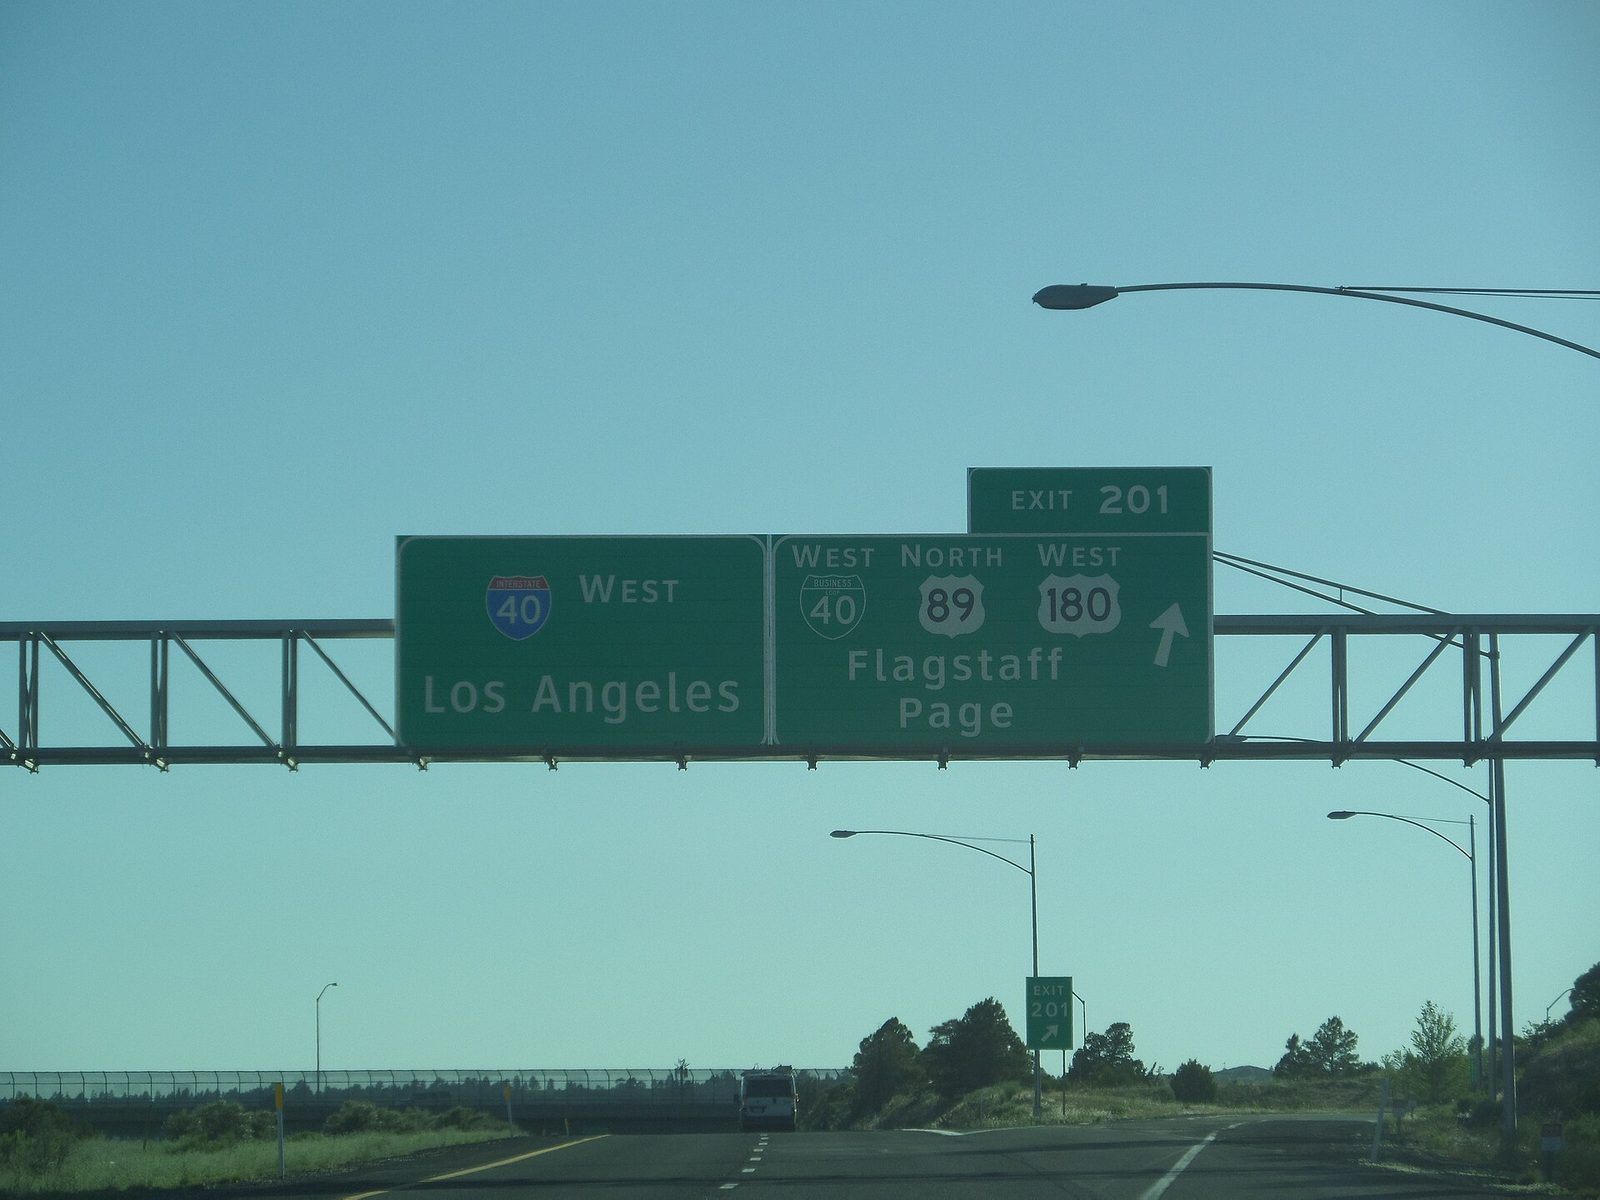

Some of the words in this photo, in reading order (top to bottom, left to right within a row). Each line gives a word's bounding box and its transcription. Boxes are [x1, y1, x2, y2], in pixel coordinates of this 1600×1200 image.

[1012, 490, 1073, 510] EXIT
[1099, 484, 1168, 514] 201
[791, 544, 875, 568] WEST
[901, 543, 1003, 567] NORTH
[1037, 543, 1122, 567] WEST
[495, 579, 541, 589] INTERSTATE
[579, 574, 680, 603] WEST
[813, 578, 853, 588] BUSINESS
[496, 595, 541, 625] 40
[810, 595, 856, 625] 40
[926, 587, 975, 623] 89
[1047, 586, 1112, 623] 180
[848, 647, 1063, 691] Flagstaff
[424, 675, 506, 713] Los
[531, 671, 741, 725] Angeles
[899, 697, 1014, 738] Page
[1033, 985, 1065, 996] EXIT
[1031, 1002, 1069, 1017] 201
